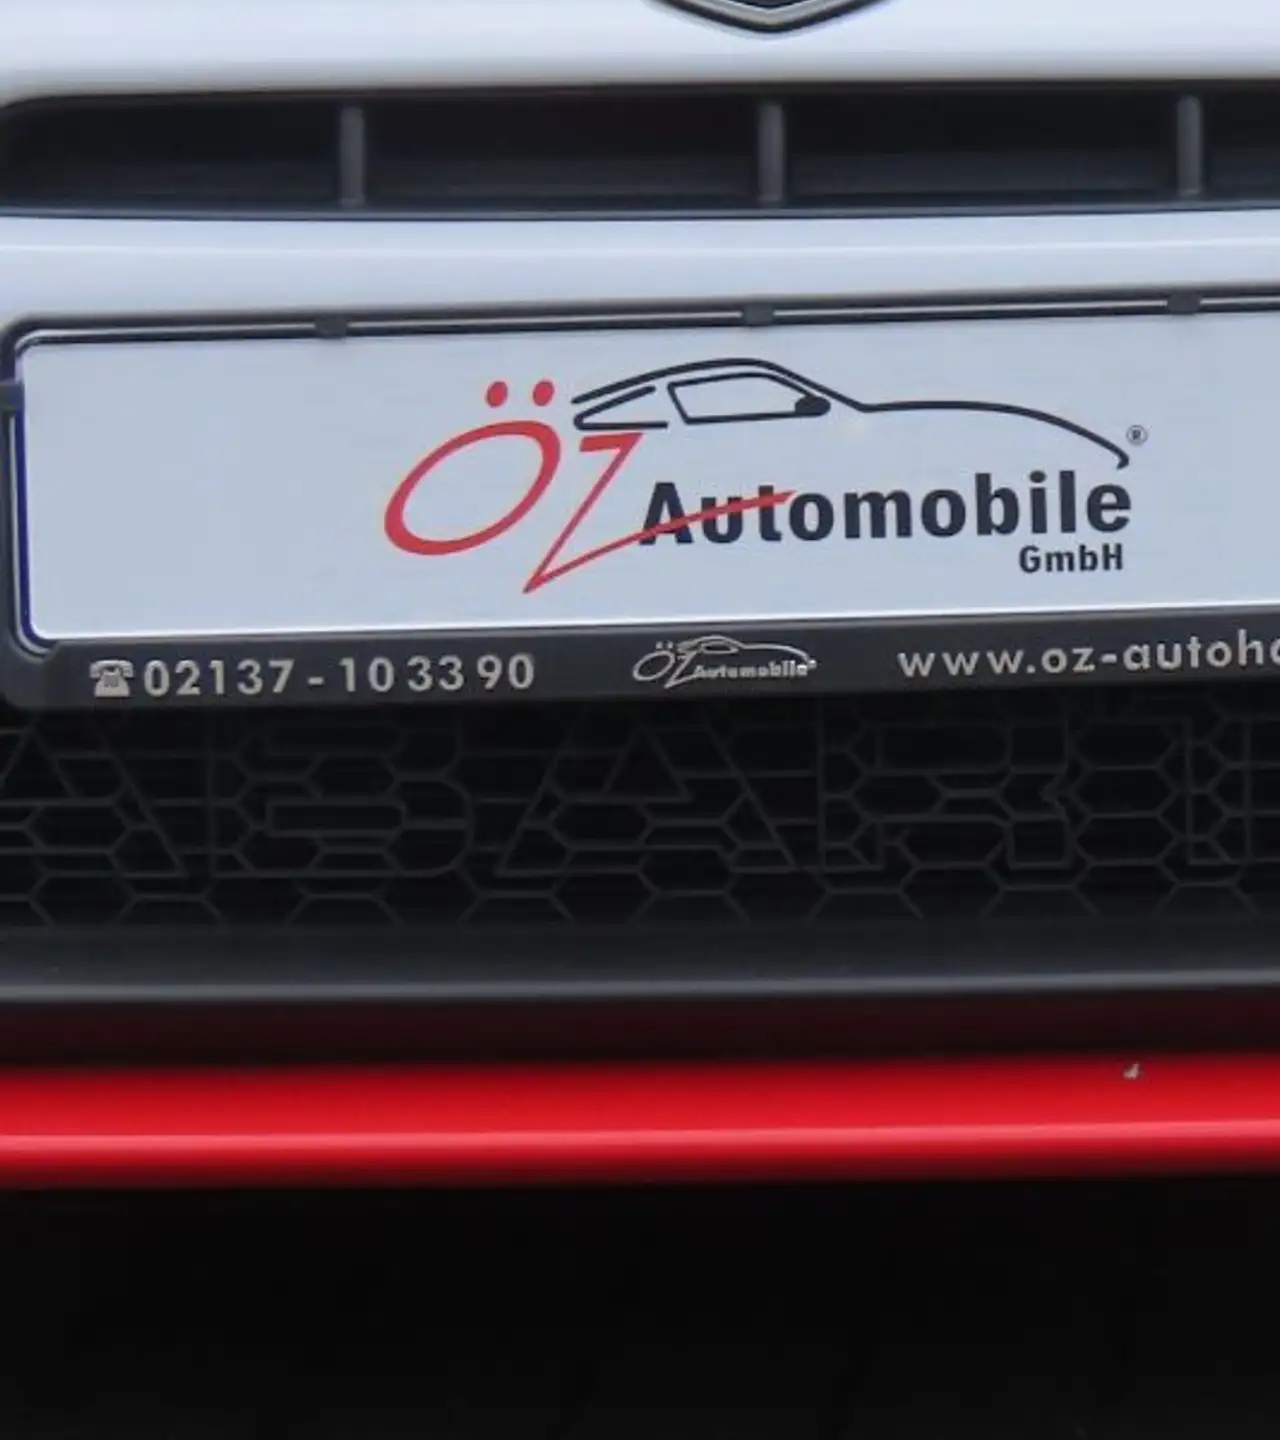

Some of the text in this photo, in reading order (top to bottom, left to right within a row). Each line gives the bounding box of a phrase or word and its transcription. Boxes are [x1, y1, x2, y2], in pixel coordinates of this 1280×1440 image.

[383, 380, 1133, 593] ÖZ Automobile
[1018, 543, 1125, 574] GmbH
[144, 658, 295, 696] 02137
